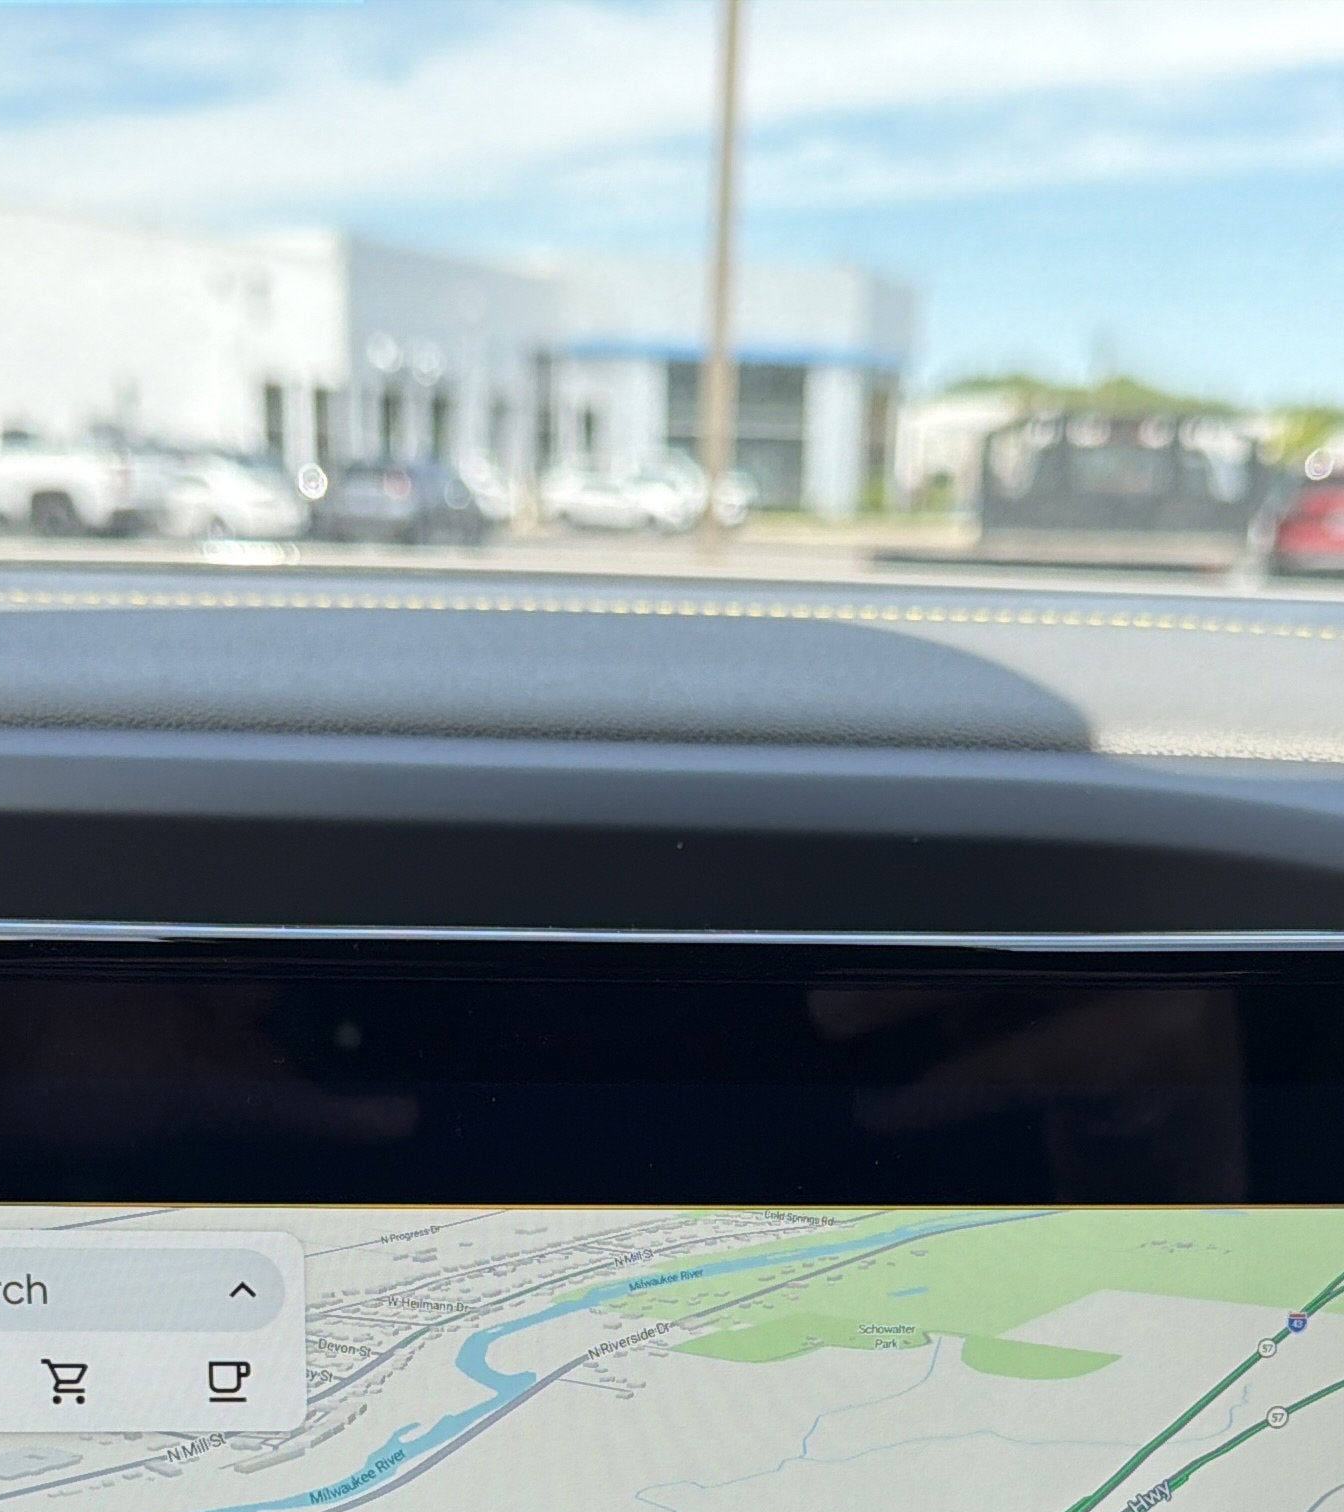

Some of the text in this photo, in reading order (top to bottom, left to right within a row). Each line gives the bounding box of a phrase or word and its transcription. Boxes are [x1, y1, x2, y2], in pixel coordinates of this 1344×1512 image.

[381, 1235, 389, 1244] N
[390, 1228, 429, 1241] Progress
[680, 1269, 703, 1280] River
[456, 1302, 469, 1312] Dr
[859, 1324, 916, 1334] Schowalter
[1291, 1319, 1303, 1328] 43
[588, 1321, 670, 1360] N Riverside Dr
[875, 1339, 897, 1348] Park
[318, 1338, 371, 1357] Devon St
[1262, 1343, 1273, 1353] 57
[320, 1370, 333, 1382] St
[1271, 1412, 1285, 1423] 57
[167, 1432, 226, 1462] N Mill St
[309, 1449, 406, 1505] Milwaukee River
